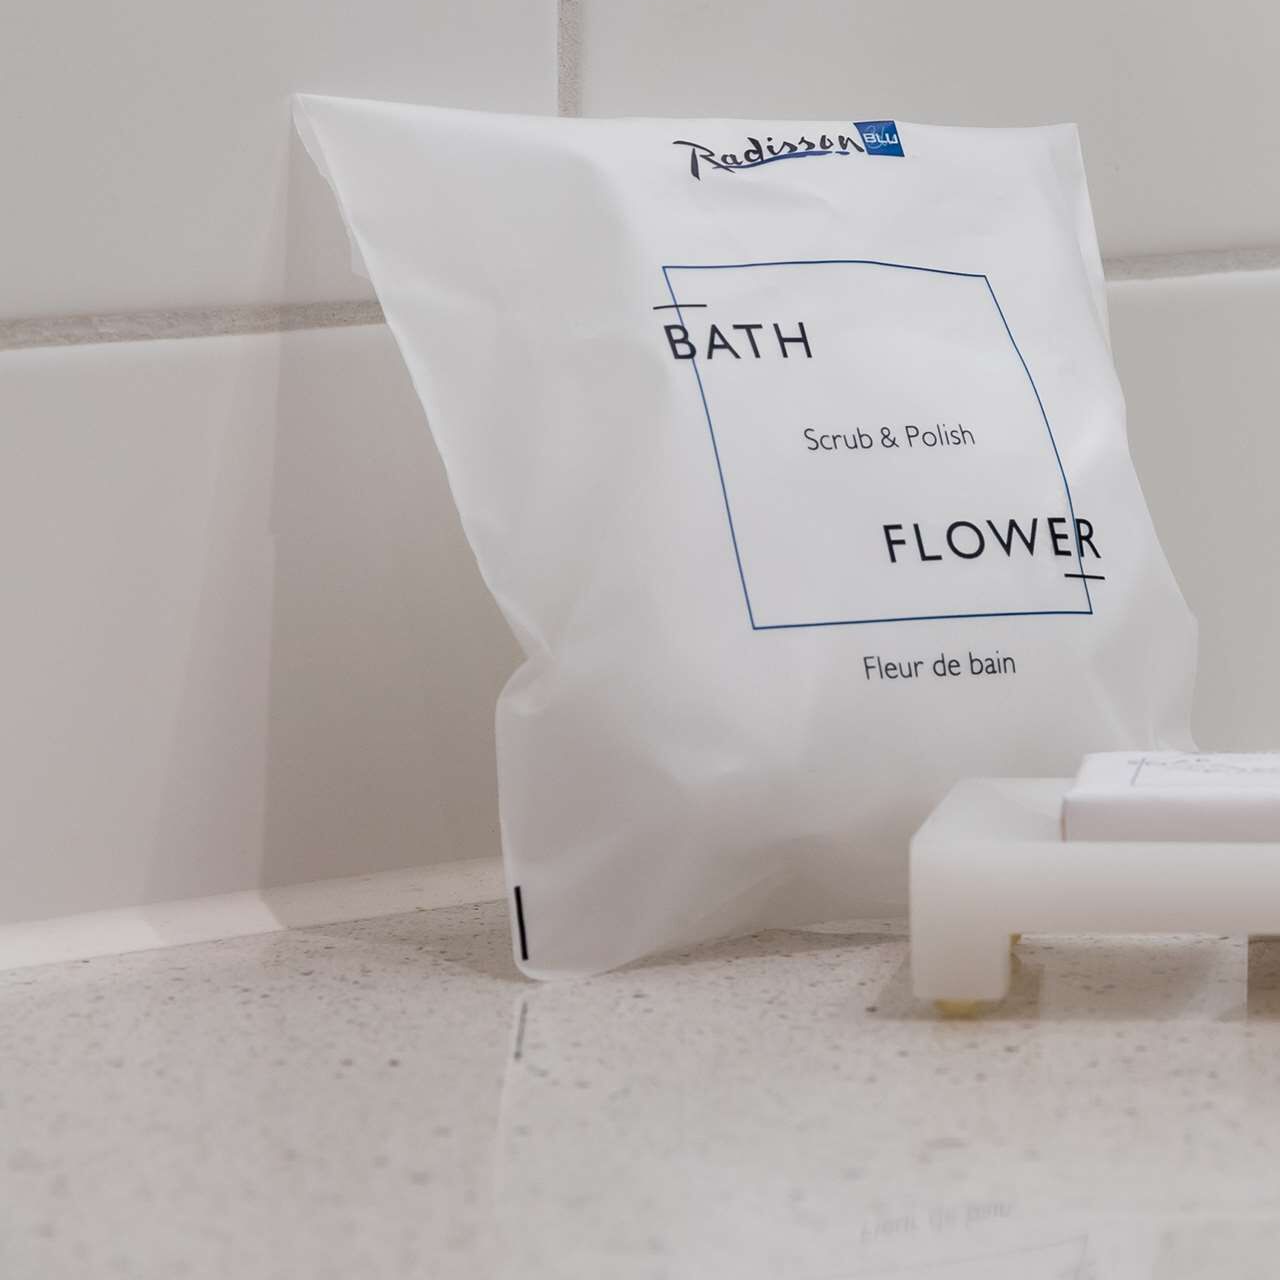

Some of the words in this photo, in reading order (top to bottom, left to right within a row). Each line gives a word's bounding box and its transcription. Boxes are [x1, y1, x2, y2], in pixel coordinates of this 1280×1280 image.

[672, 134, 865, 181] Radisson
[663, 322, 813, 360] BATH
[804, 426, 874, 451] Scrub
[880, 426, 900, 449] &
[905, 423, 976, 447] Polish
[882, 517, 1102, 563] FLOWER
[863, 654, 924, 680] Fleur
[932, 653, 961, 677] de
[969, 650, 1017, 675] bain
